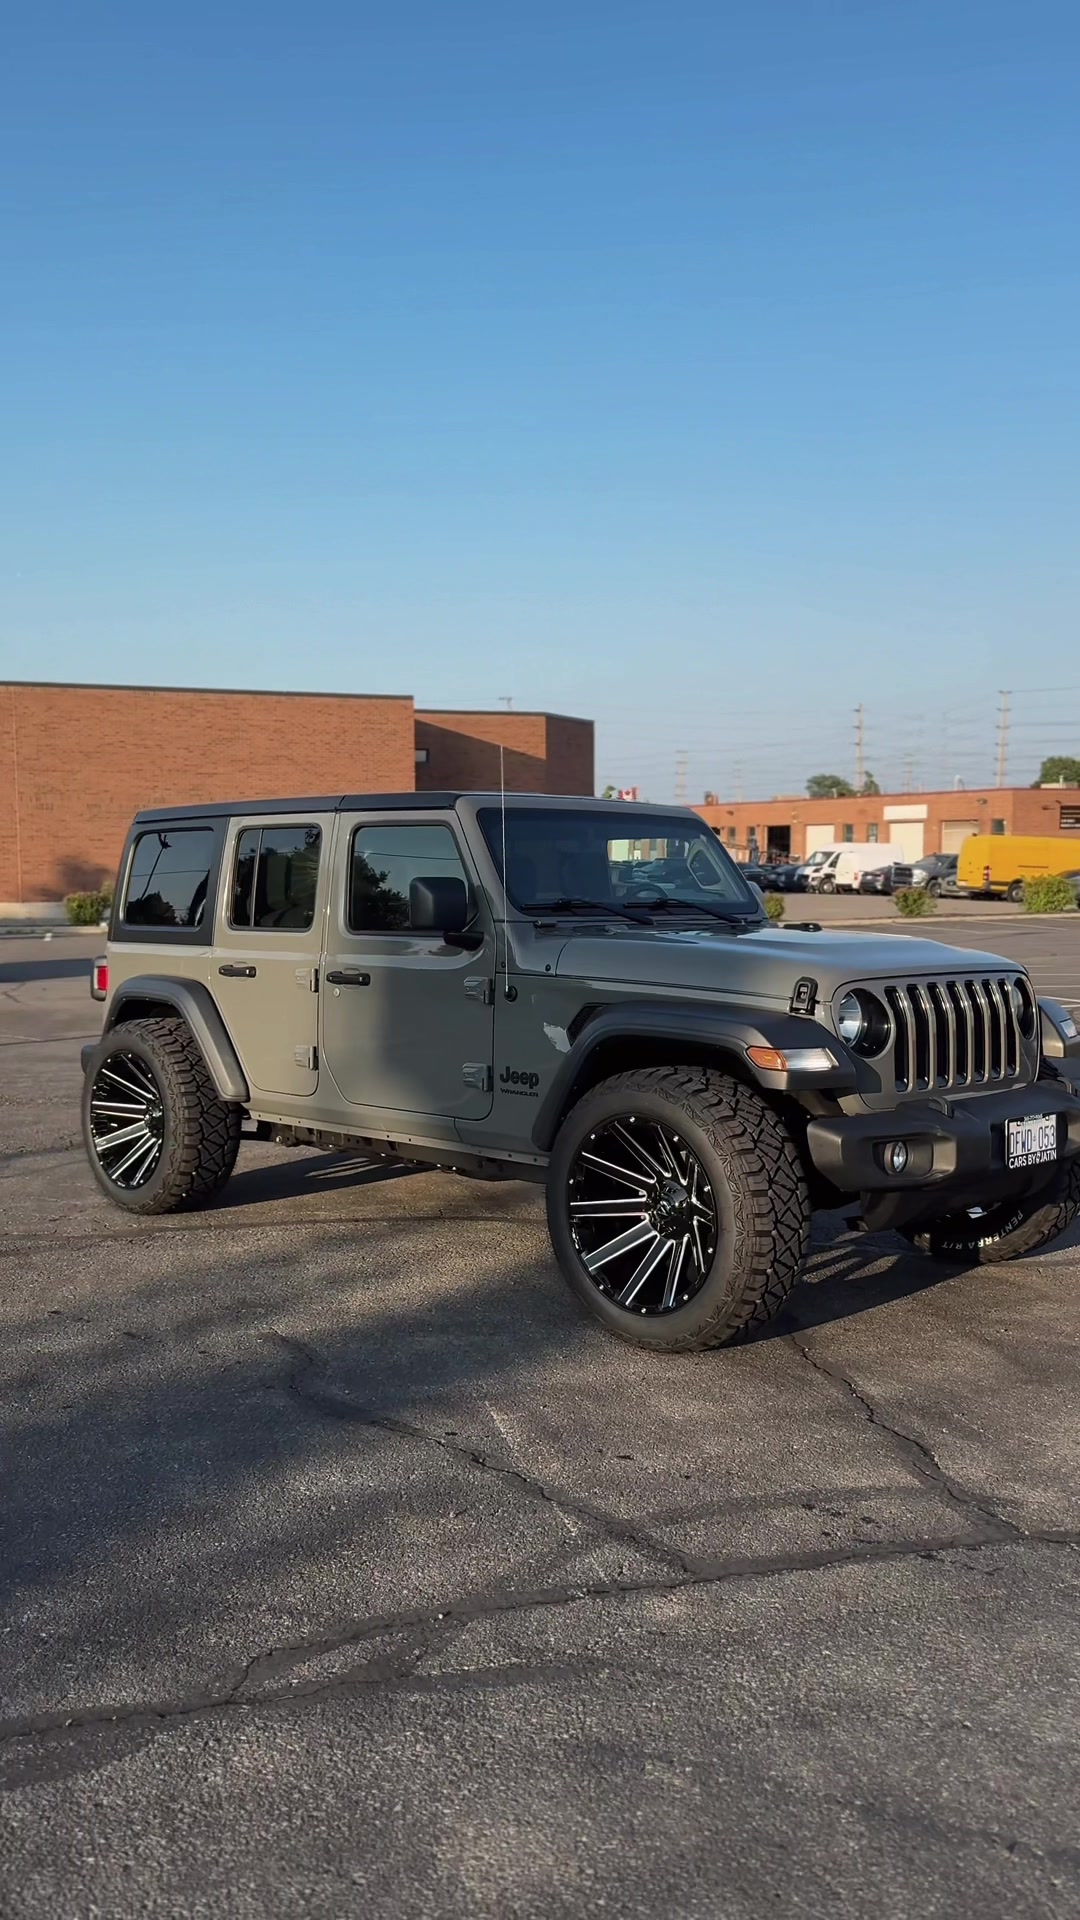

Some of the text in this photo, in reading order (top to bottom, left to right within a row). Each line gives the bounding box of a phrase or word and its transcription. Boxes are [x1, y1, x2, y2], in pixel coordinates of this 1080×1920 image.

[499, 1066, 540, 1089] Jeep
[500, 1087, 539, 1098] WRANGLER
[1008, 1155, 1027, 1169] CARS
[967, 1209, 1024, 1250] PENTERRA
